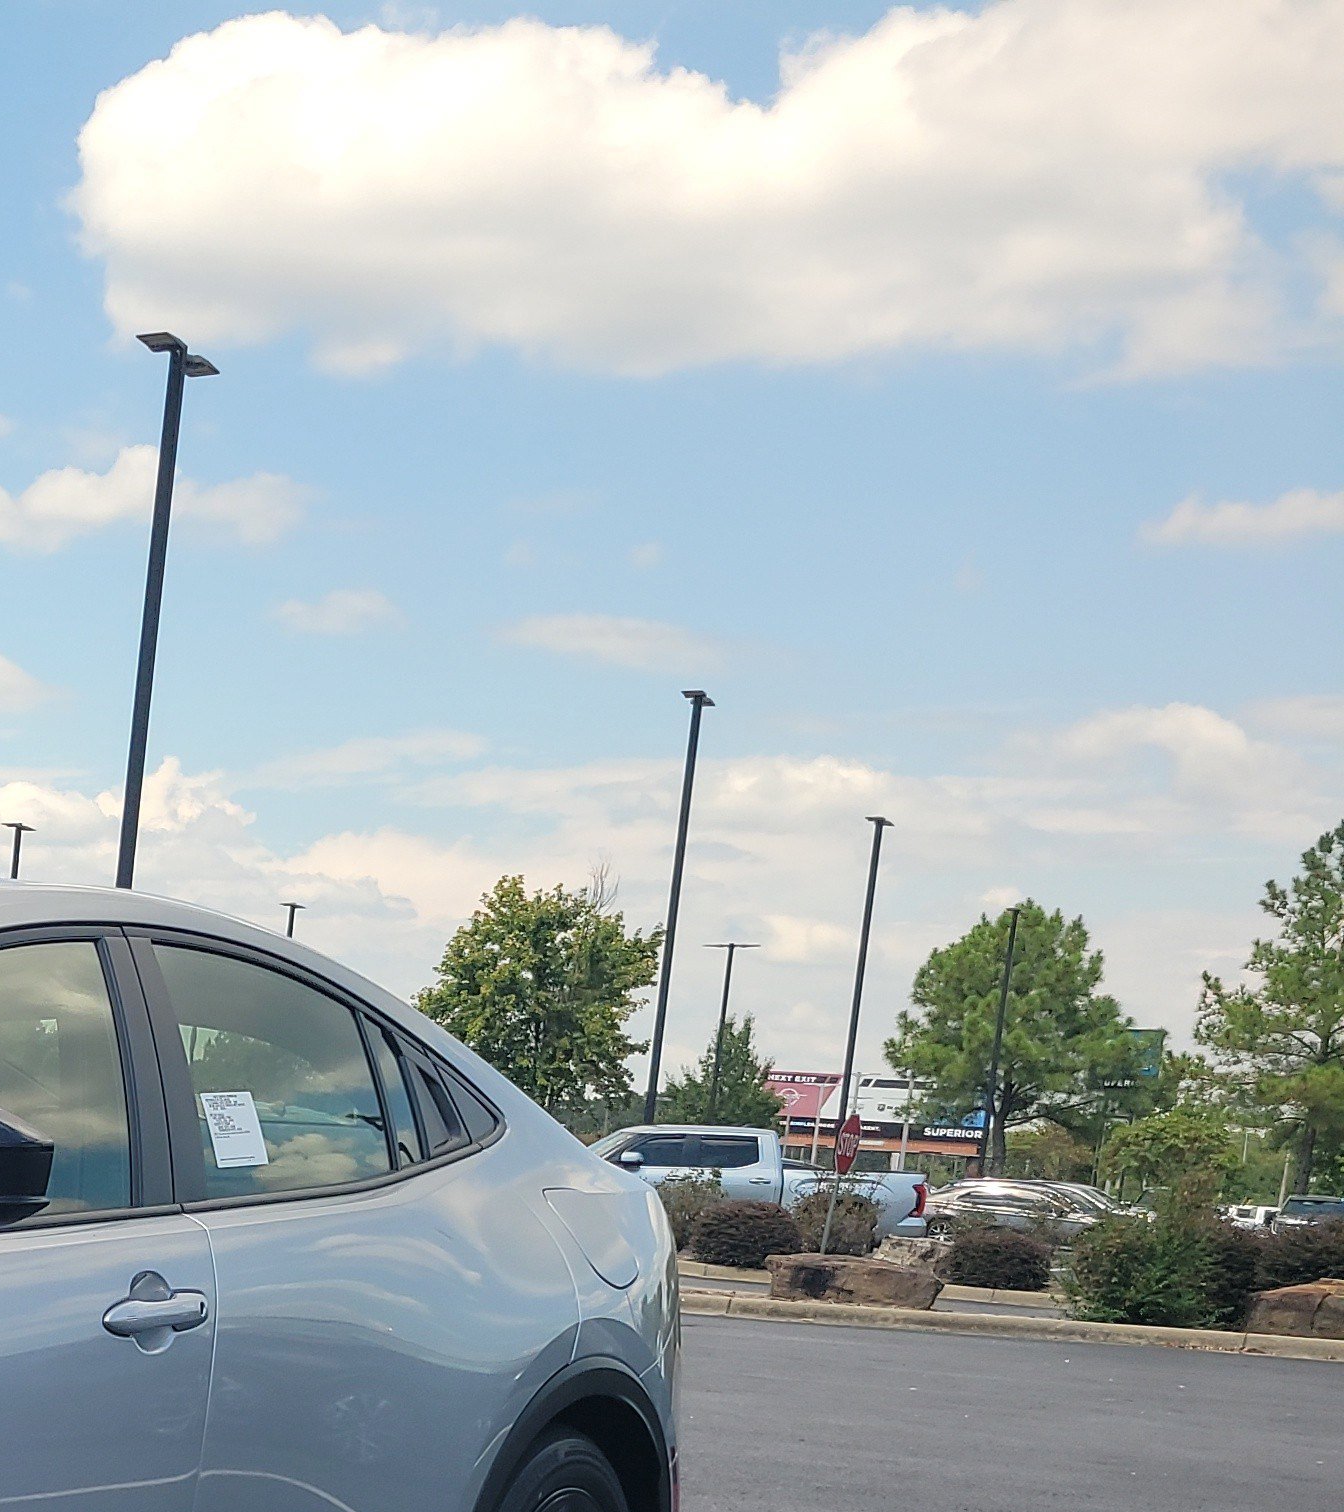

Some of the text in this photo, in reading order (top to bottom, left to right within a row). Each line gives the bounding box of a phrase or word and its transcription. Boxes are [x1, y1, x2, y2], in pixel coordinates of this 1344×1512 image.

[767, 1074, 818, 1083] NEXT EXIT
[923, 1126, 984, 1139] SUPERIOR
[837, 1132, 859, 1157] STOP
